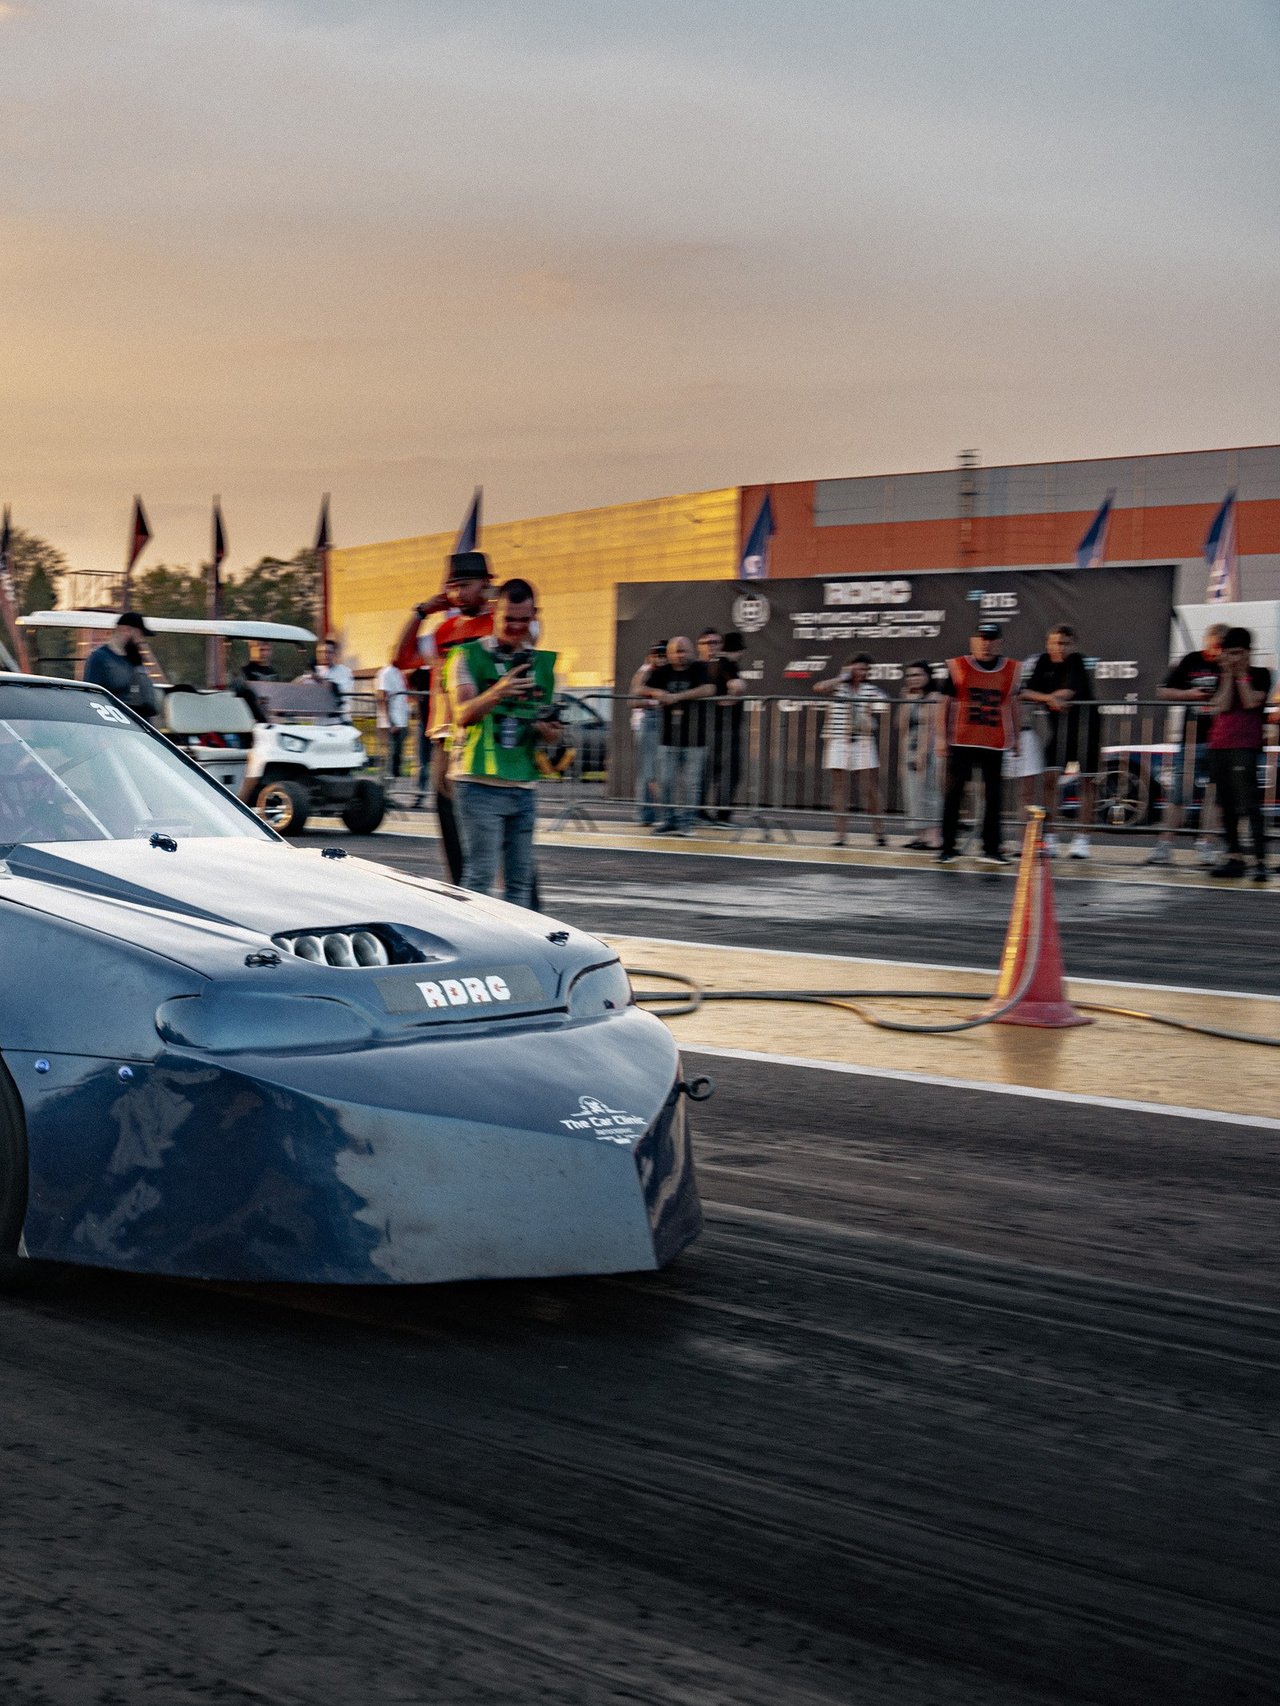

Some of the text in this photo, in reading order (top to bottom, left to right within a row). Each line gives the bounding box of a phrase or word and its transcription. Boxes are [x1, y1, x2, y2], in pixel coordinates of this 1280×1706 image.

[90, 702, 131, 725] 20
[560, 1119, 592, 1131] The
[588, 1116, 614, 1127] Car
